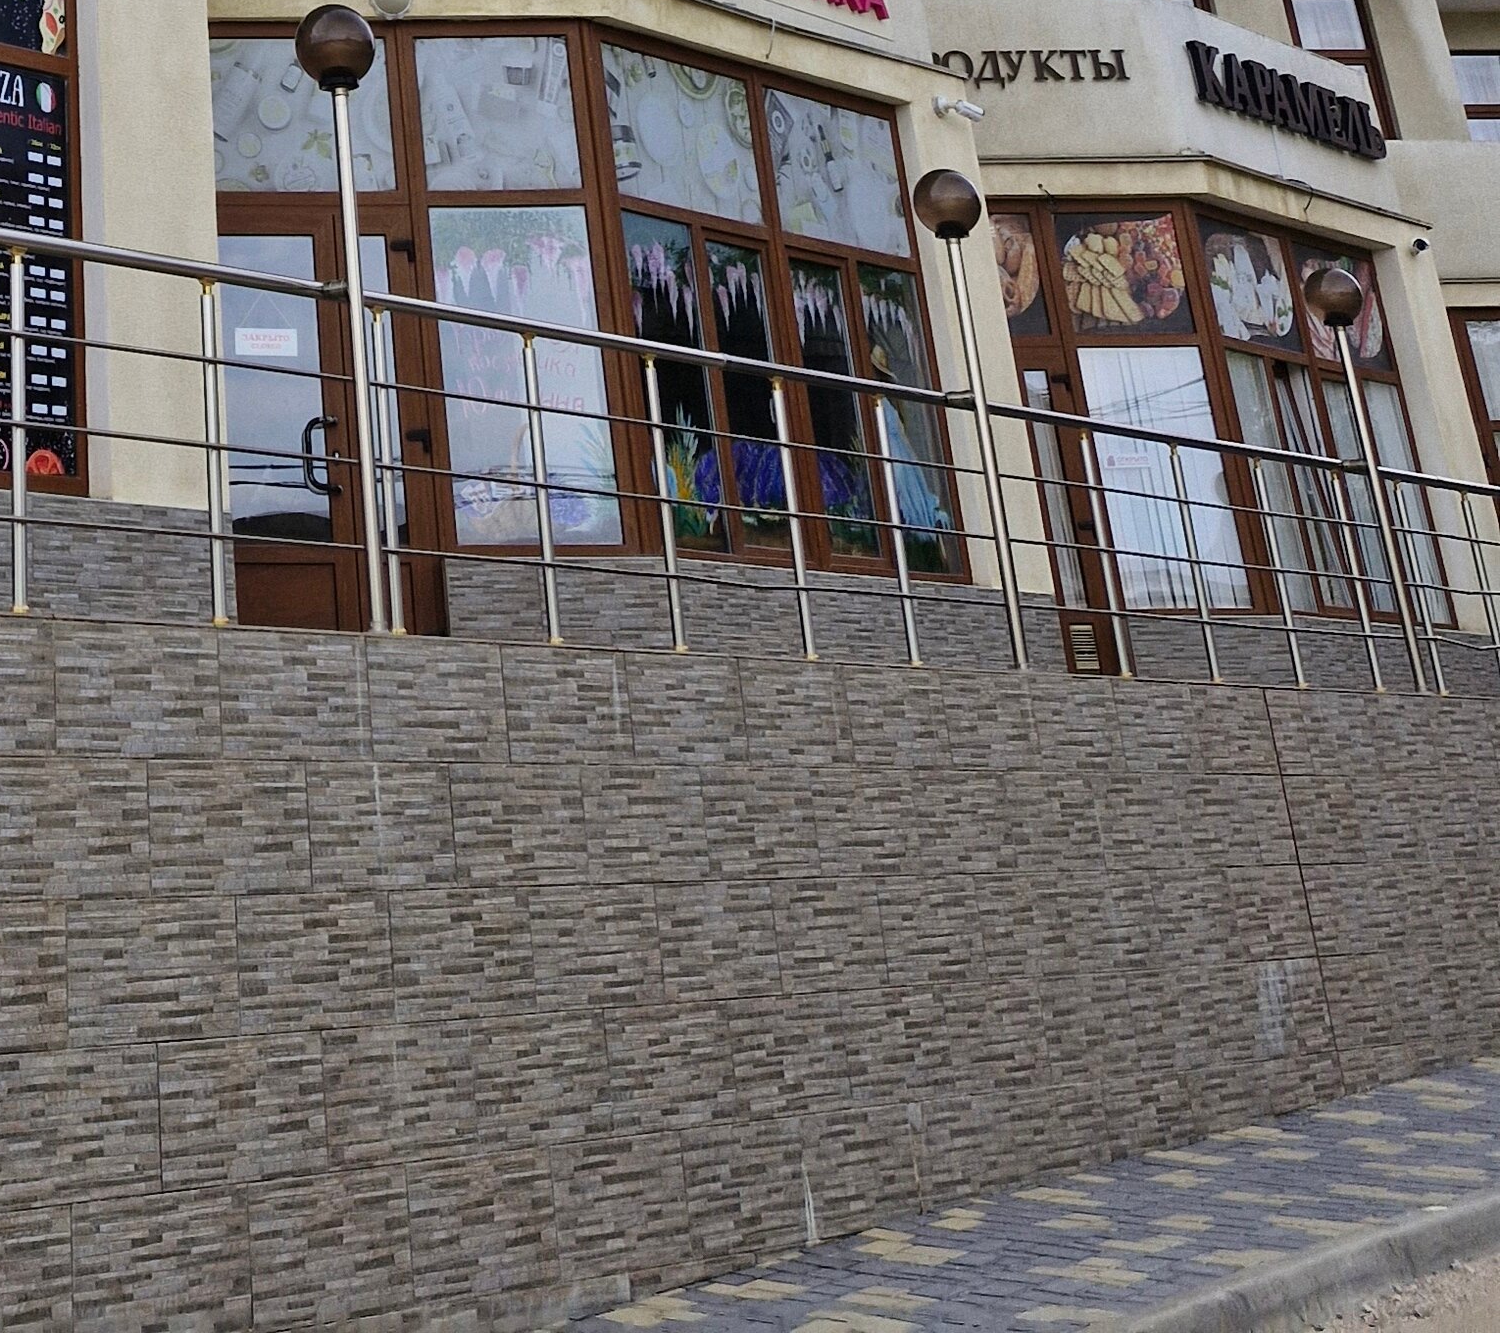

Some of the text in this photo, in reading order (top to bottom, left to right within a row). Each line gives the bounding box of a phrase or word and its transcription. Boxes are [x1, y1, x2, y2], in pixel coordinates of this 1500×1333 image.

[932, 50, 1130, 89] ОДУКТЫ
[1186, 40, 1387, 160] КАРАМЕЛЬ
[28, 114, 62, 135] Italian
